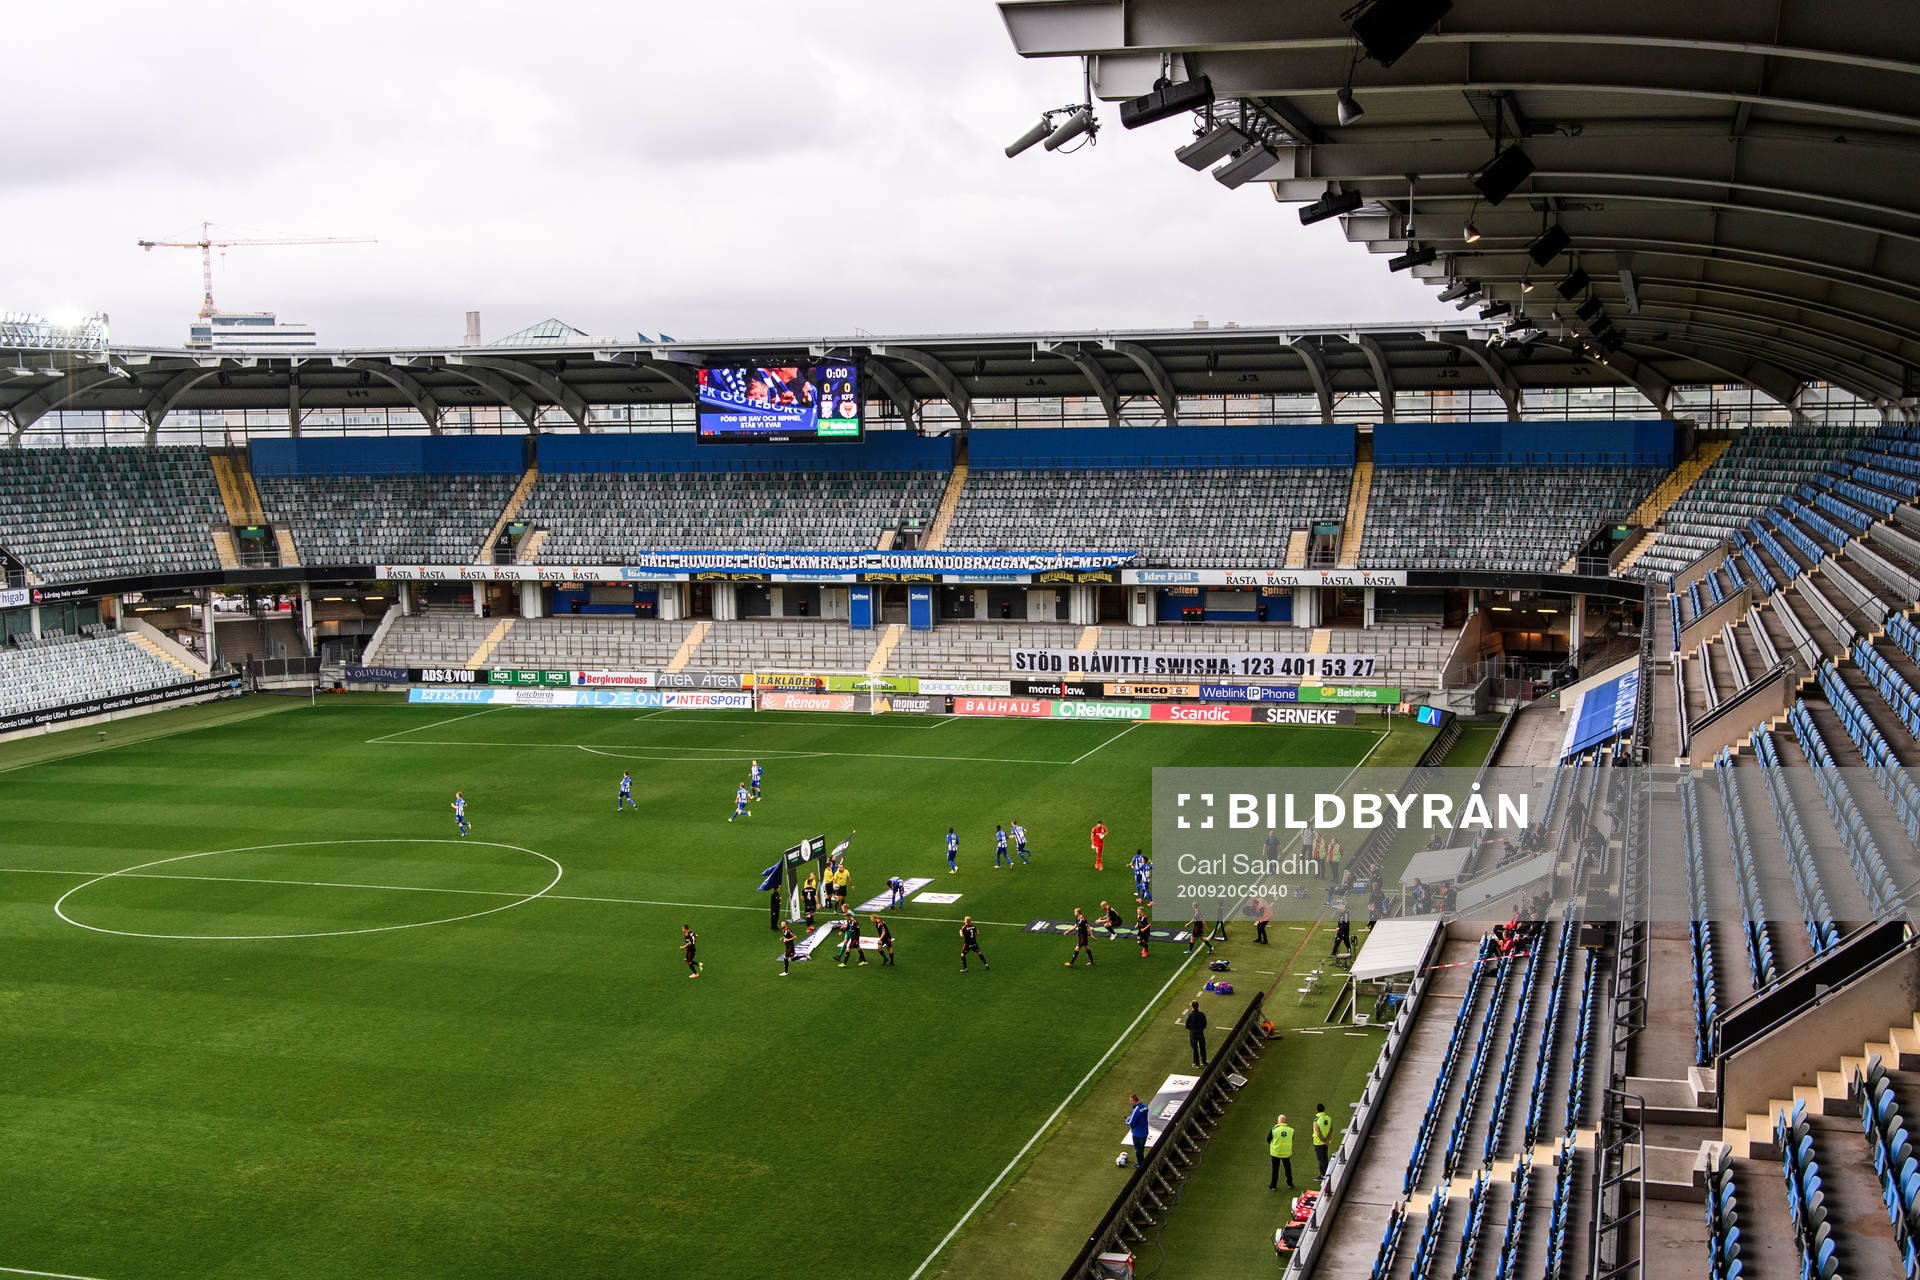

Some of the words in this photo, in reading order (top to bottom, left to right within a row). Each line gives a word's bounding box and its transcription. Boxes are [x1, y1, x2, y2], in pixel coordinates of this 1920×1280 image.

[826, 368, 848, 379] 0:00
[700, 385, 716, 398] FK
[823, 383, 830, 393] 0
[844, 382, 851, 393] 0
[1594, 541, 1604, 550] J1
[640, 552, 674, 568] HÅLL
[680, 555, 743, 569] HUVUDET
[749, 552, 785, 569] HÖGT
[790, 555, 868, 569] KAMRATER
[881, 555, 1029, 570] KOMMANDOBRYGGAN
[1035, 553, 1074, 570] STÅR
[387, 571, 412, 579] RASTA
[420, 571, 445, 579] RASTA
[460, 571, 486, 579] RASTA
[538, 572, 565, 580] RASTA
[573, 572, 599, 580] RASTA
[1144, 571, 1166, 581] Idre
[1226, 576, 1258, 584] RASTA
[1267, 576, 1299, 585] RASTA
[1321, 577, 1353, 585] RASTA
[1363, 577, 1396, 586] RASTA
[2, 592, 25, 605] higab
[1016, 651, 1061, 672] STÖD
[1069, 651, 1149, 674] BLÅVITT!
[1155, 657, 1235, 675] SWISHA:
[1241, 658, 1274, 675] 123
[1281, 658, 1315, 676] 401
[1322, 659, 1346, 676] 53
[1353, 659, 1373, 677] 27
[355, 668, 398, 679] OLIVEDAL
[422, 669, 475, 683] ADS4YOU
[587, 674, 648, 686] Bergkvarabuss
[1029, 685, 1061, 695] morris
[1064, 686, 1085, 696] law.
[1202, 687, 1246, 699] Weblink
[1261, 688, 1296, 699] Phone
[1320, 687, 1336, 697] GP
[1337, 688, 1377, 697] Batteries
[676, 695, 747, 706] INTERSPORT
[784, 694, 830, 709] Renova
[966, 701, 1040, 713] BAUHAUS
[1076, 702, 1142, 718] Rekomo
[1170, 706, 1230, 721] Scandic
[1266, 708, 1337, 724] SERNEKE
